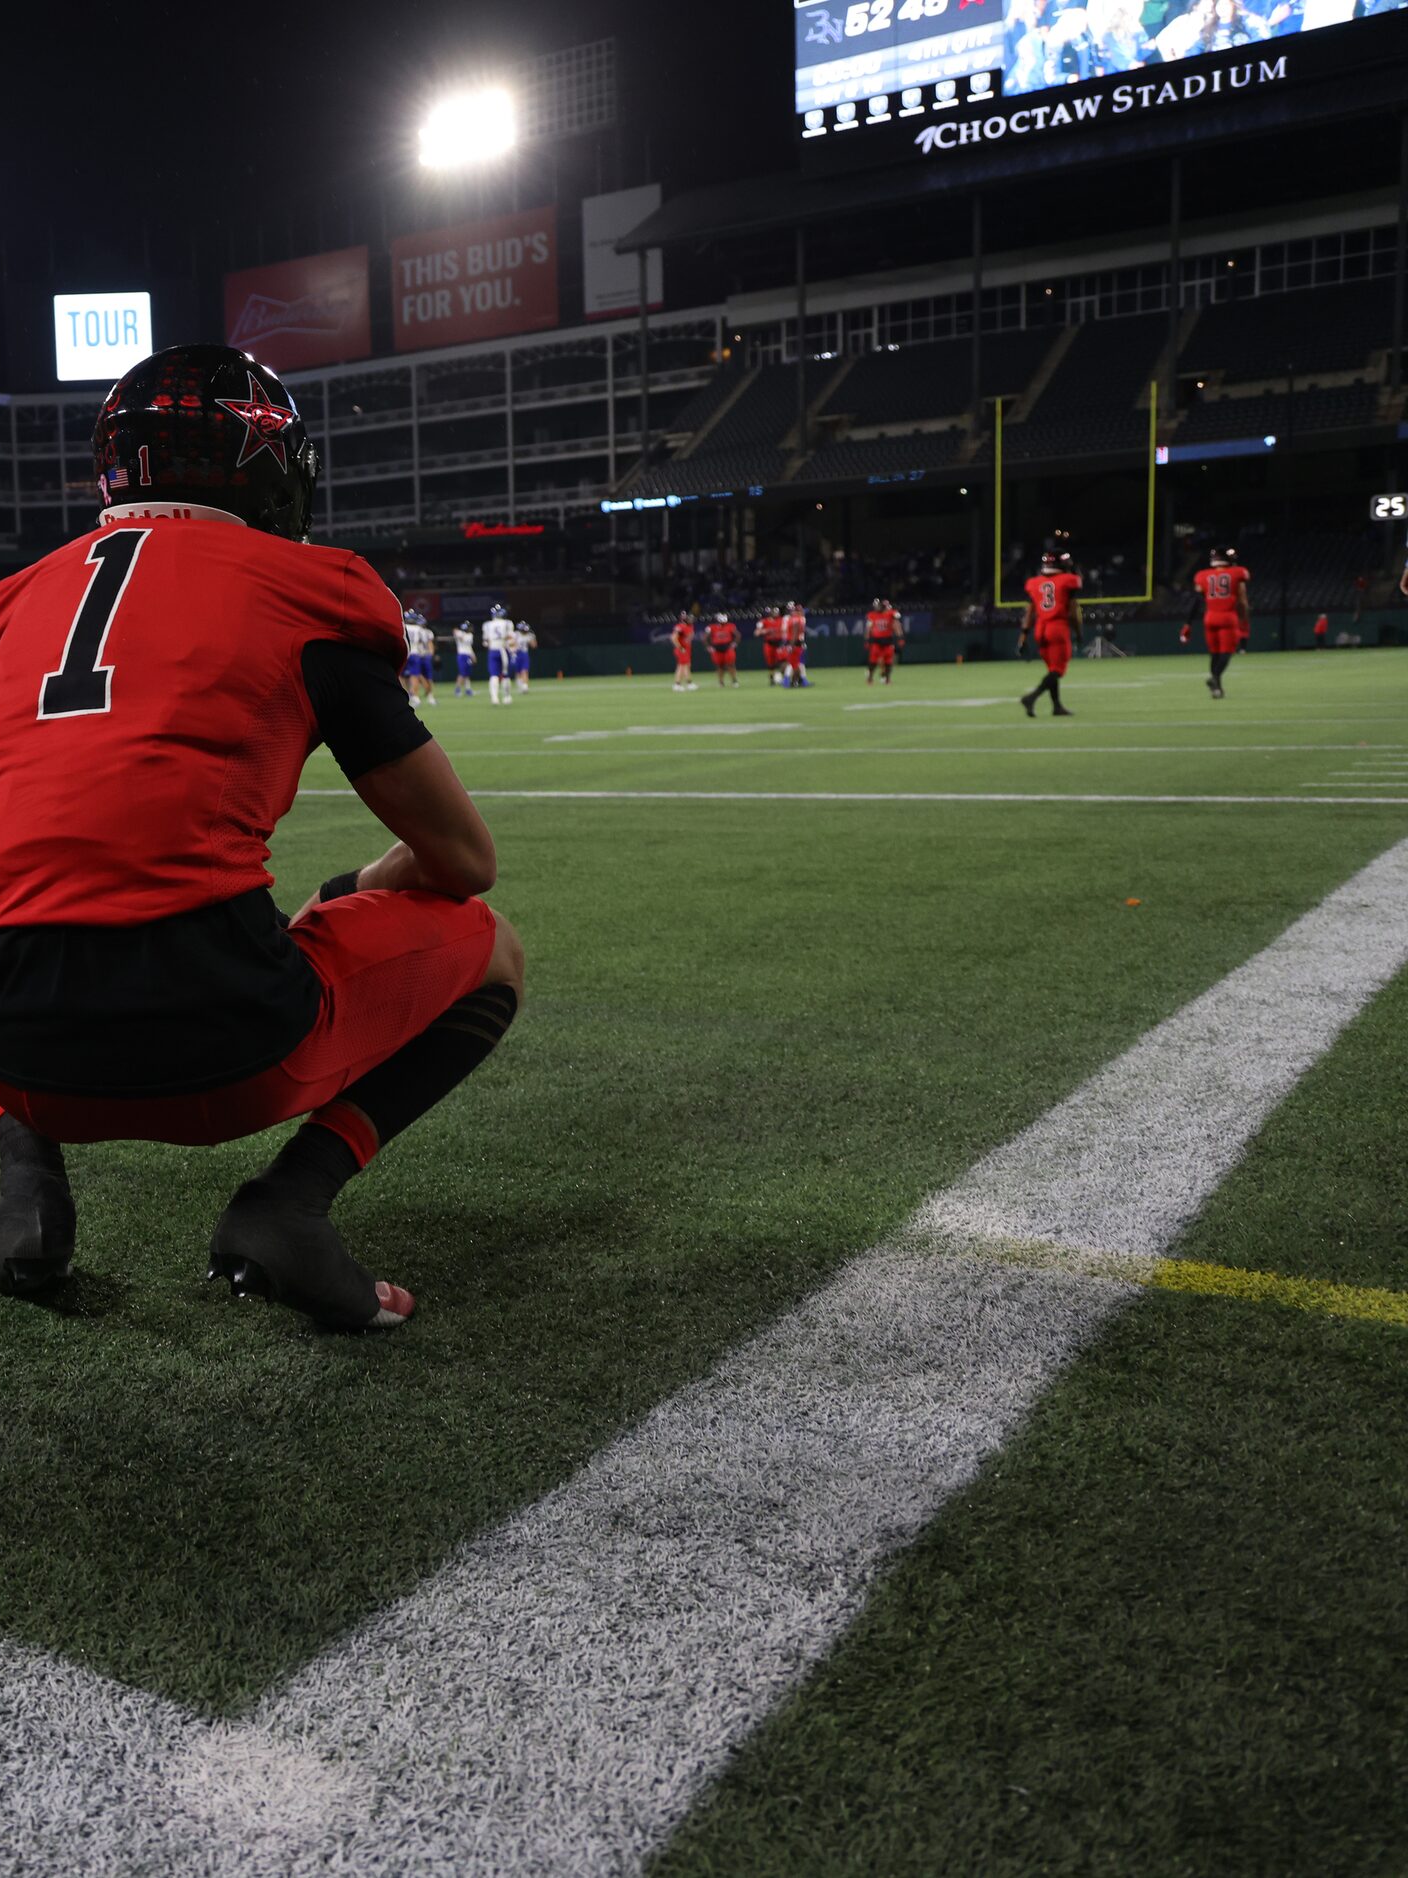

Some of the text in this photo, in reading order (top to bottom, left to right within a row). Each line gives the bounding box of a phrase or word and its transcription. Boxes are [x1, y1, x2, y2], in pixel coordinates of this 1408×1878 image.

[845, 0, 894, 37] 52
[933, 56, 1288, 150] CHOCTAW STADIUM
[400, 231, 550, 289] THIS BUD'S
[401, 277, 522, 325] FOR YOU.
[67, 309, 139, 347] TOUR
[138, 445, 152, 486] 1
[1375, 496, 1406, 518] 25
[1039, 581, 1057, 612] 3
[1206, 573, 1232, 599] 19
[36, 528, 153, 720] 1
